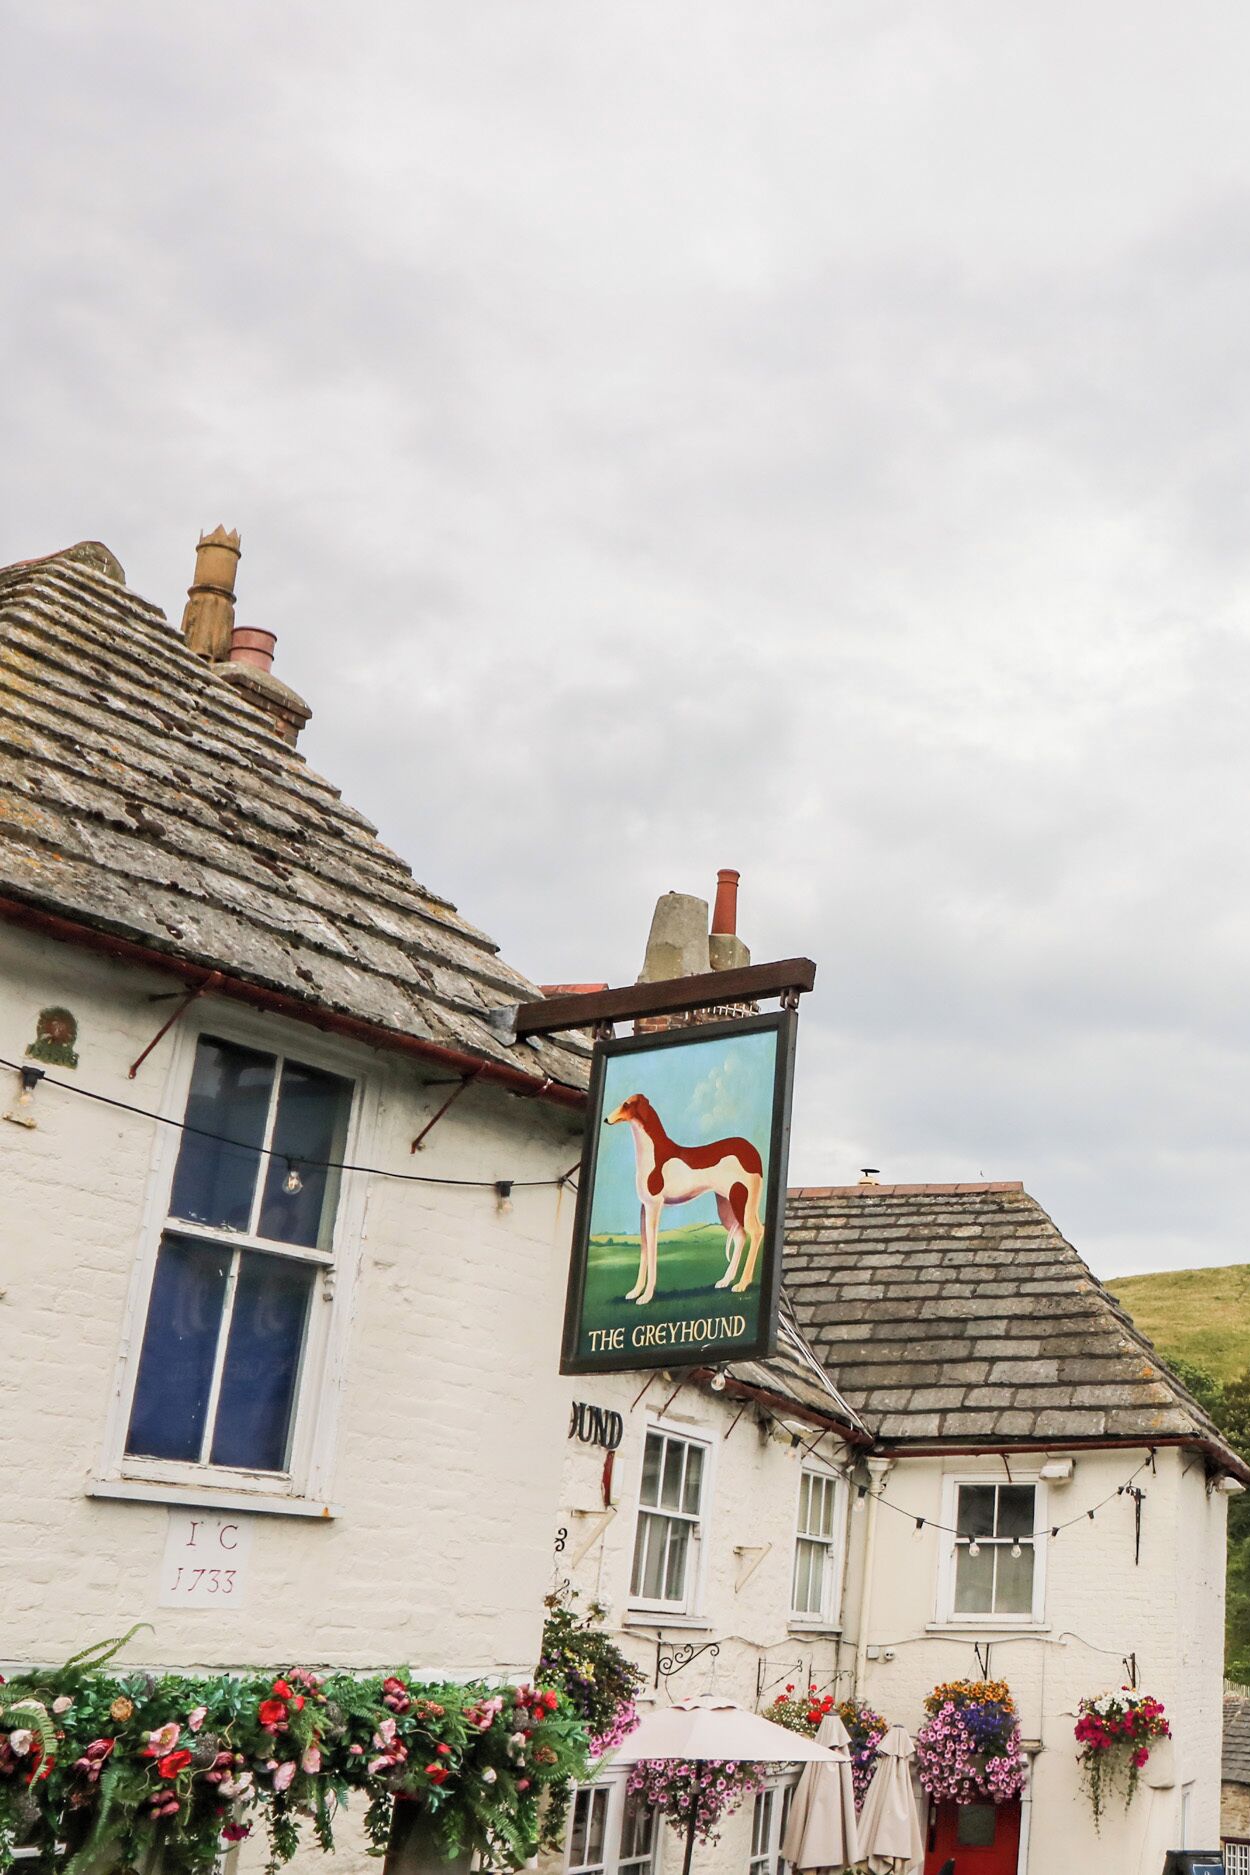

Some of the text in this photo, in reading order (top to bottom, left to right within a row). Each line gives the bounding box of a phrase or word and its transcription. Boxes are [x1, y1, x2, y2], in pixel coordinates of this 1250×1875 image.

[588, 1315, 746, 1352] THE GREYHOUND
[170, 1567, 237, 1593] 1733
